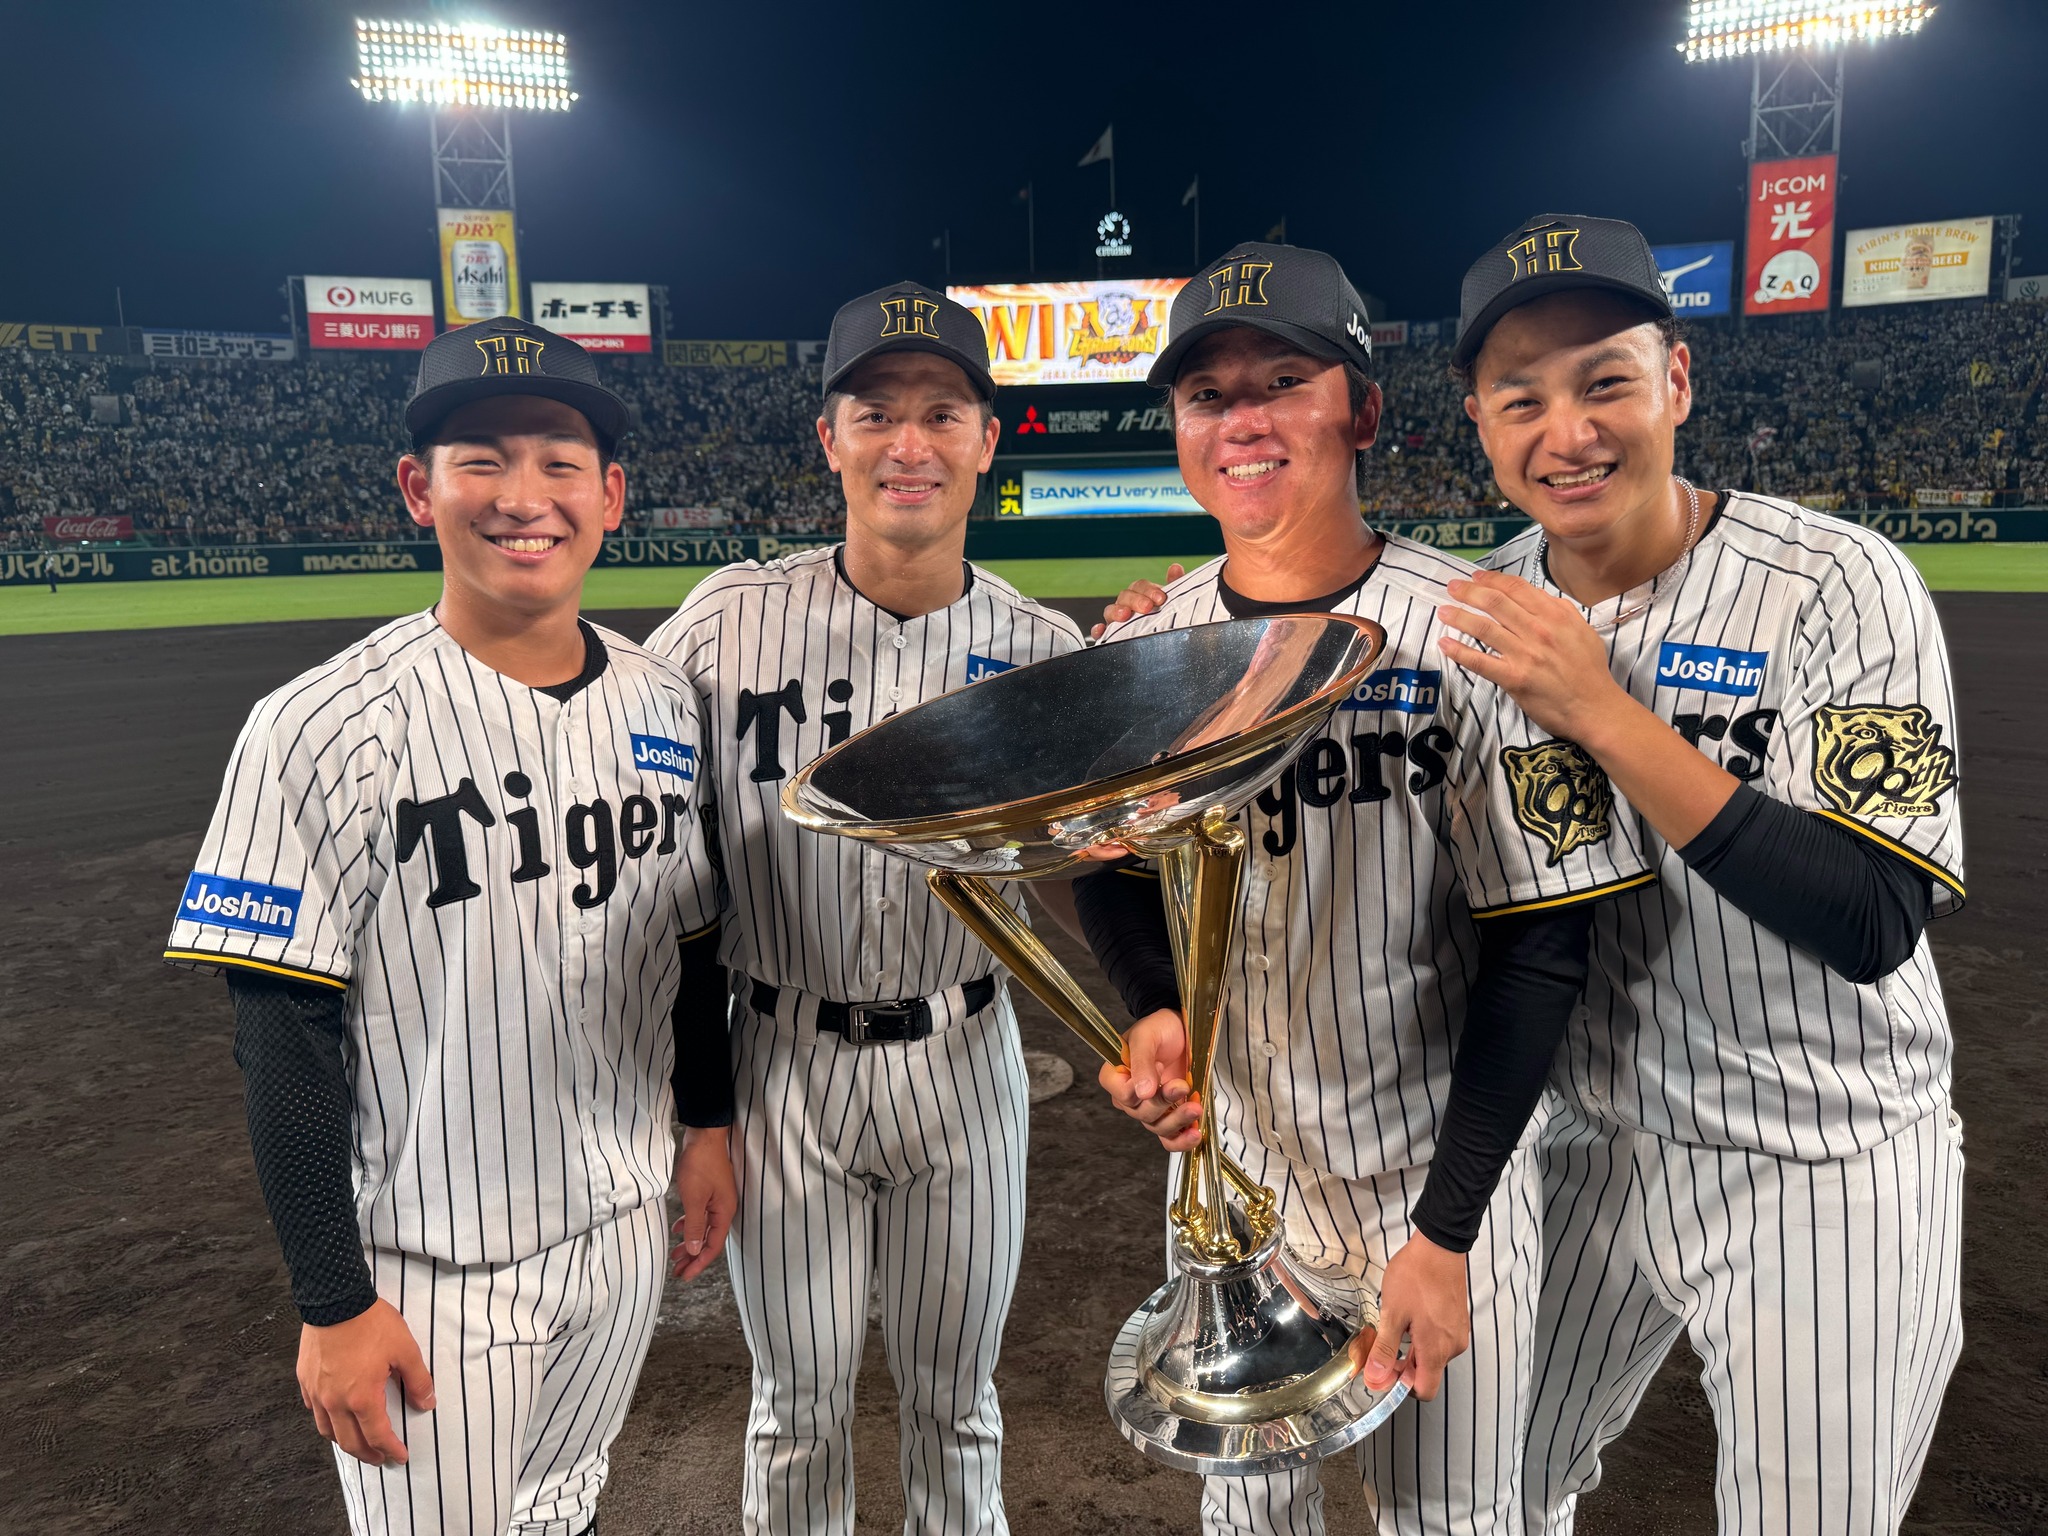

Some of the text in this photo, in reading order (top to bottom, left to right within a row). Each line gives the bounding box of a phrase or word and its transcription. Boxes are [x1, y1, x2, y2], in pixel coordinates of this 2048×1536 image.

[1758, 174, 1826, 202] J:COM
[1769, 201, 1816, 241] 光
[1904, 227, 1942, 238] PRIME
[1945, 227, 1980, 245] BREW
[1868, 260, 1901, 273] KIRIN
[1931, 253, 1963, 267] BEER
[457, 264, 504, 284] Asahi
[1766, 274, 1813, 294] ZAQ
[359, 291, 414, 306] MUFG
[541, 298, 643, 319] ホーチキ
[1668, 291, 1711, 309] uno
[323, 322, 421, 340] 三菱UFJ銀行
[666, 343, 784, 365] 関西ペイント
[1048, 421, 1101, 434] ELECTRIC
[1030, 486, 1121, 500] SANKYU
[1124, 486, 1158, 498] very
[1860, 510, 1998, 540] Kubota
[605, 539, 745, 564] SUNSTAR
[151, 550, 269, 577] at home
[1660, 651, 1762, 687] Joshin
[1346, 676, 1434, 705] oshin
[635, 741, 694, 774] Joshin
[1880, 801, 1933, 816] Tigers
[396, 771, 687, 909] Tiger
[186, 883, 293, 927] Joshin
